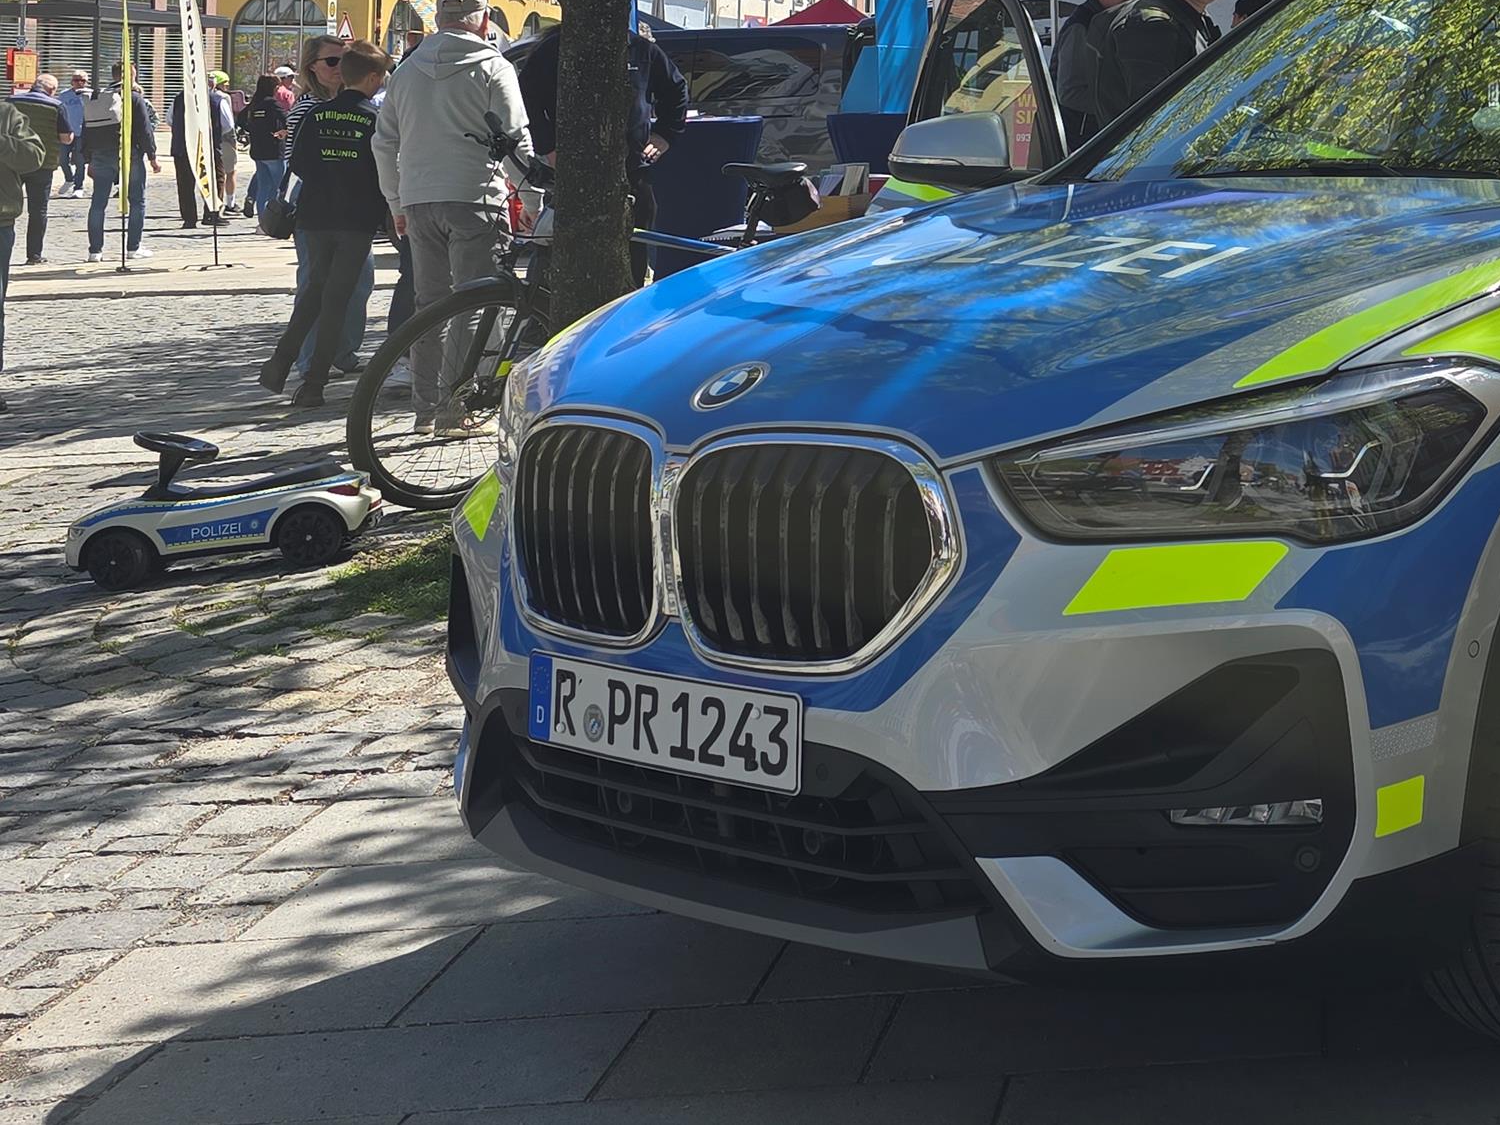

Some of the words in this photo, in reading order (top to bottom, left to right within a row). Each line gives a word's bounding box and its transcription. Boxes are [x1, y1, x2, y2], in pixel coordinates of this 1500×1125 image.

[190, 522, 242, 540] POLIZEI
[554, 668, 577, 737] R
[536, 704, 545, 724] D
